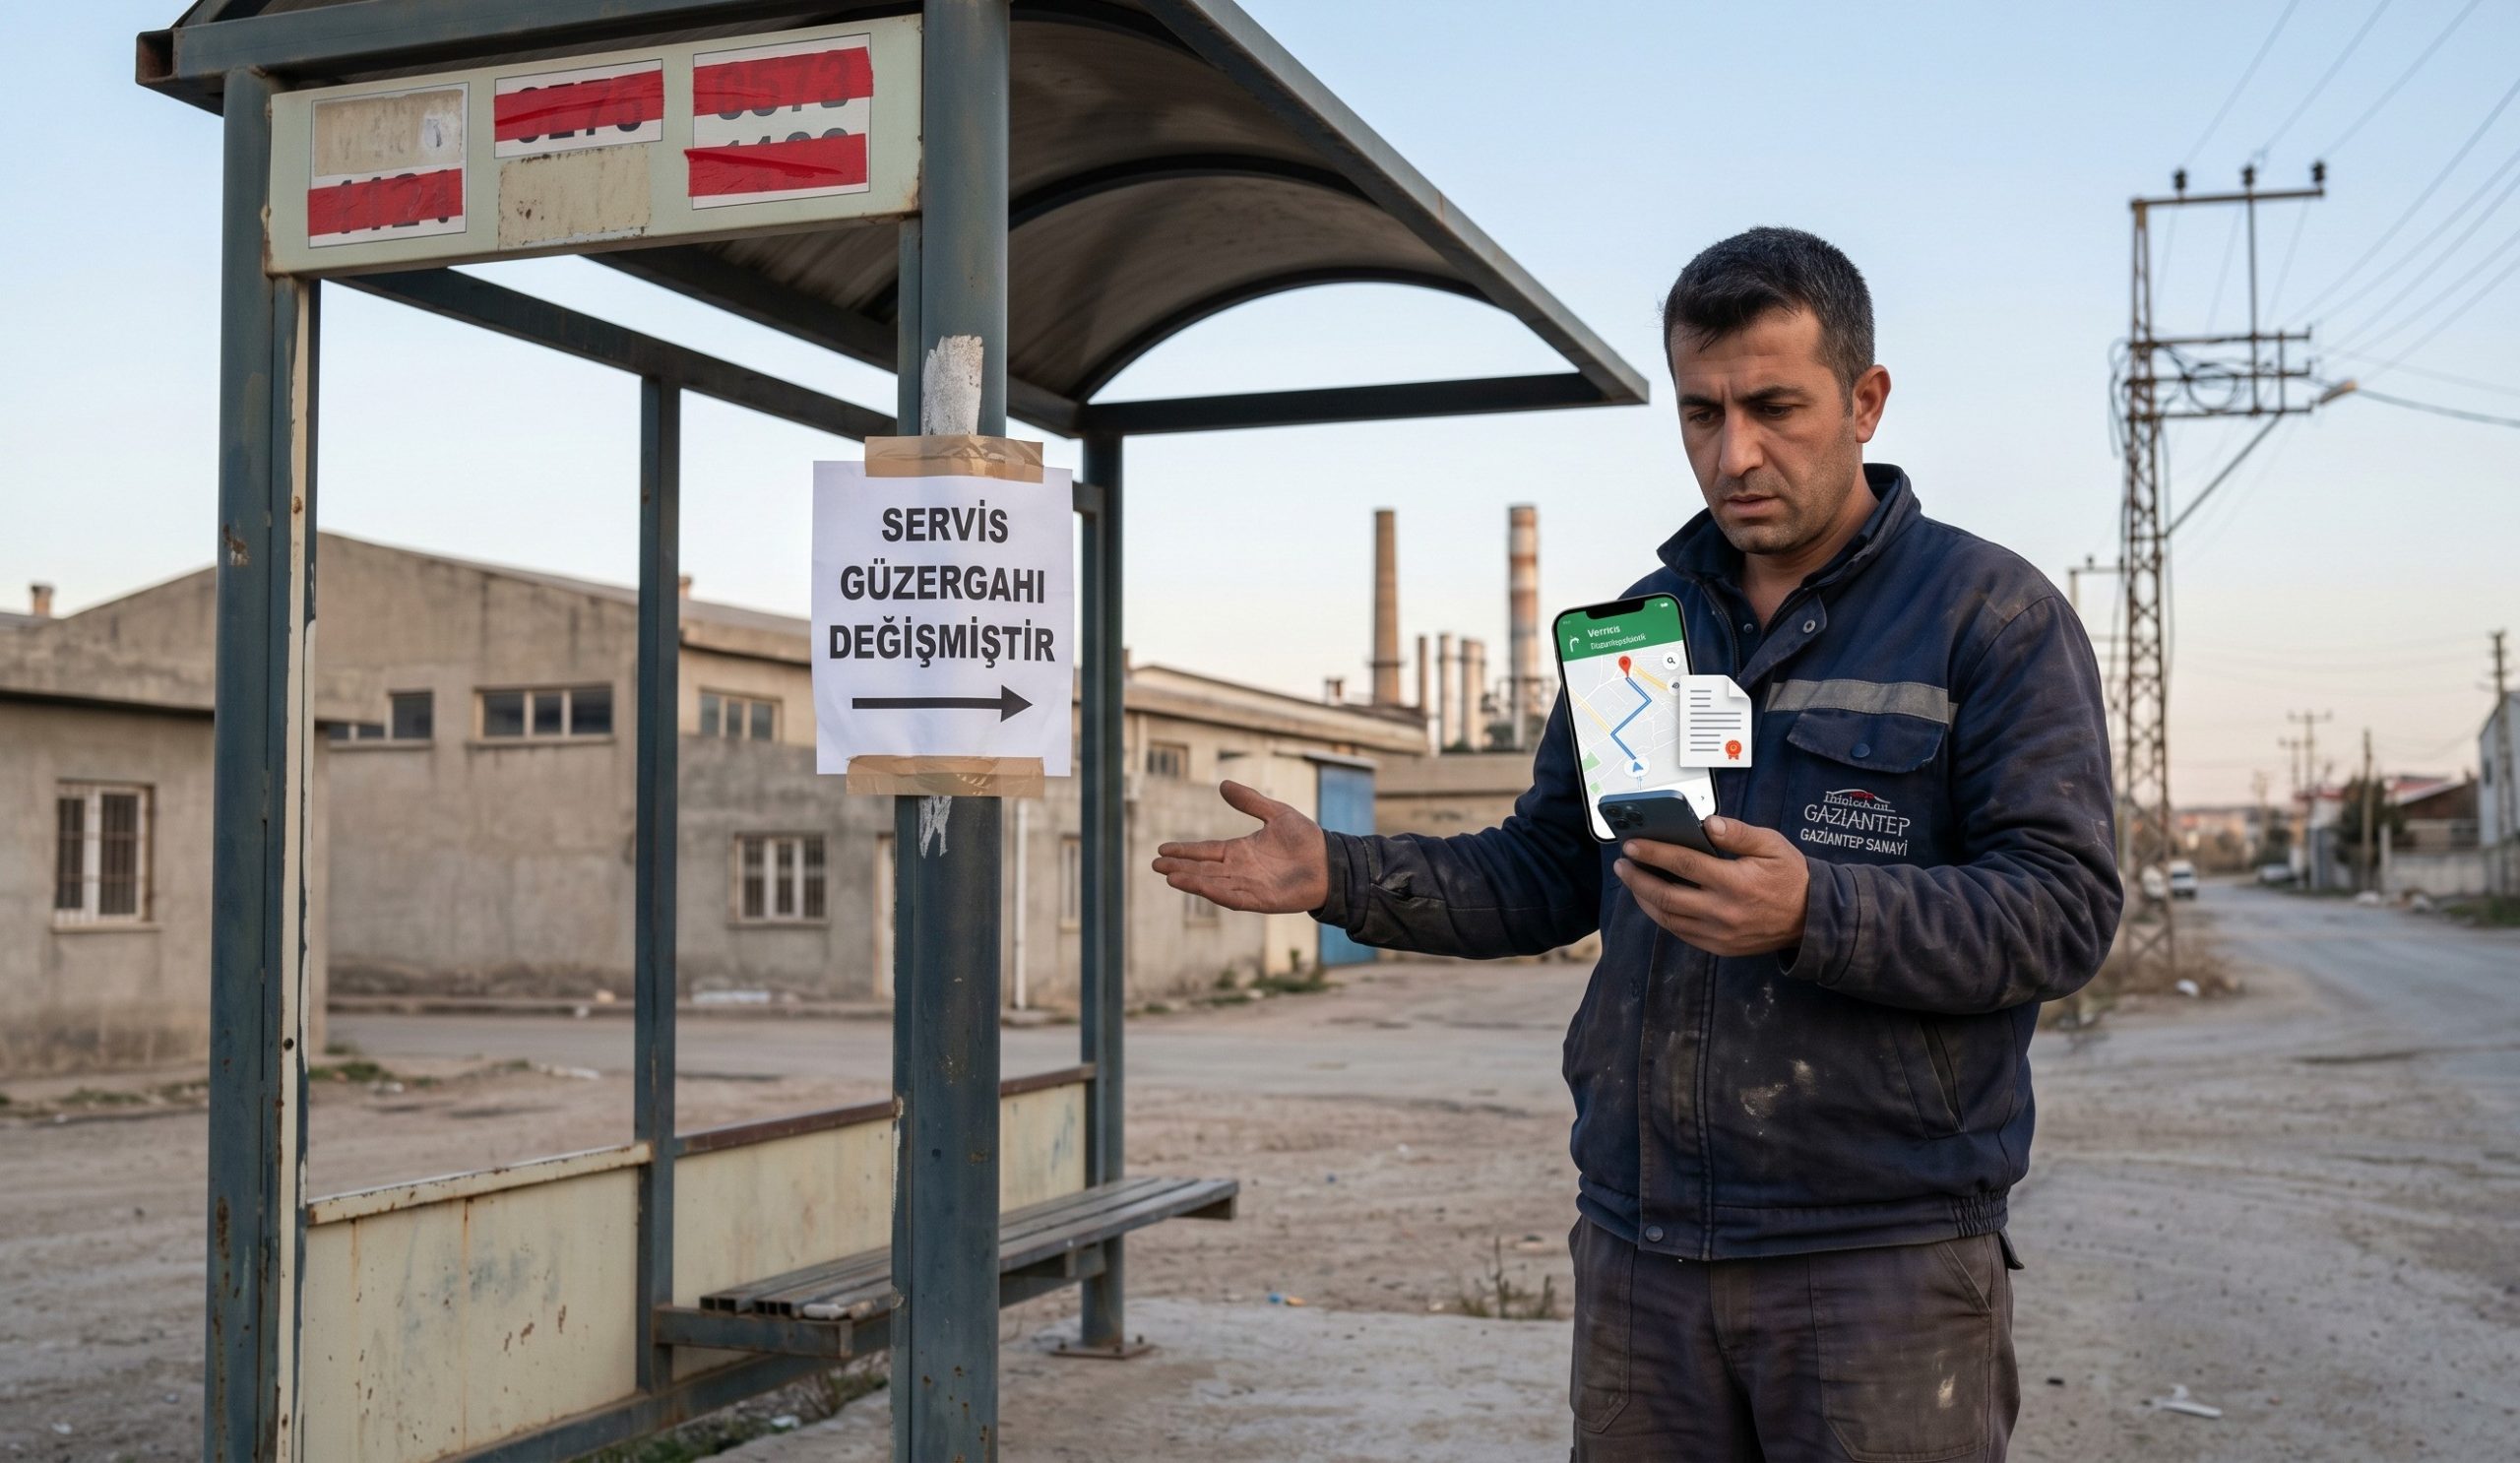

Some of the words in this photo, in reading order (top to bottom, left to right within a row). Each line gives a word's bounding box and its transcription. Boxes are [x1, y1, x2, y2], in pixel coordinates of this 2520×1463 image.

[881, 499, 1009, 543] SERVİS
[840, 557, 1045, 604] GÜZERGAHI
[829, 615, 1056, 669] DEĞİŞMİŞTİR
[1799, 827, 1864, 849] GAZİANTEP
[1865, 839, 1909, 856] SANAYİ
